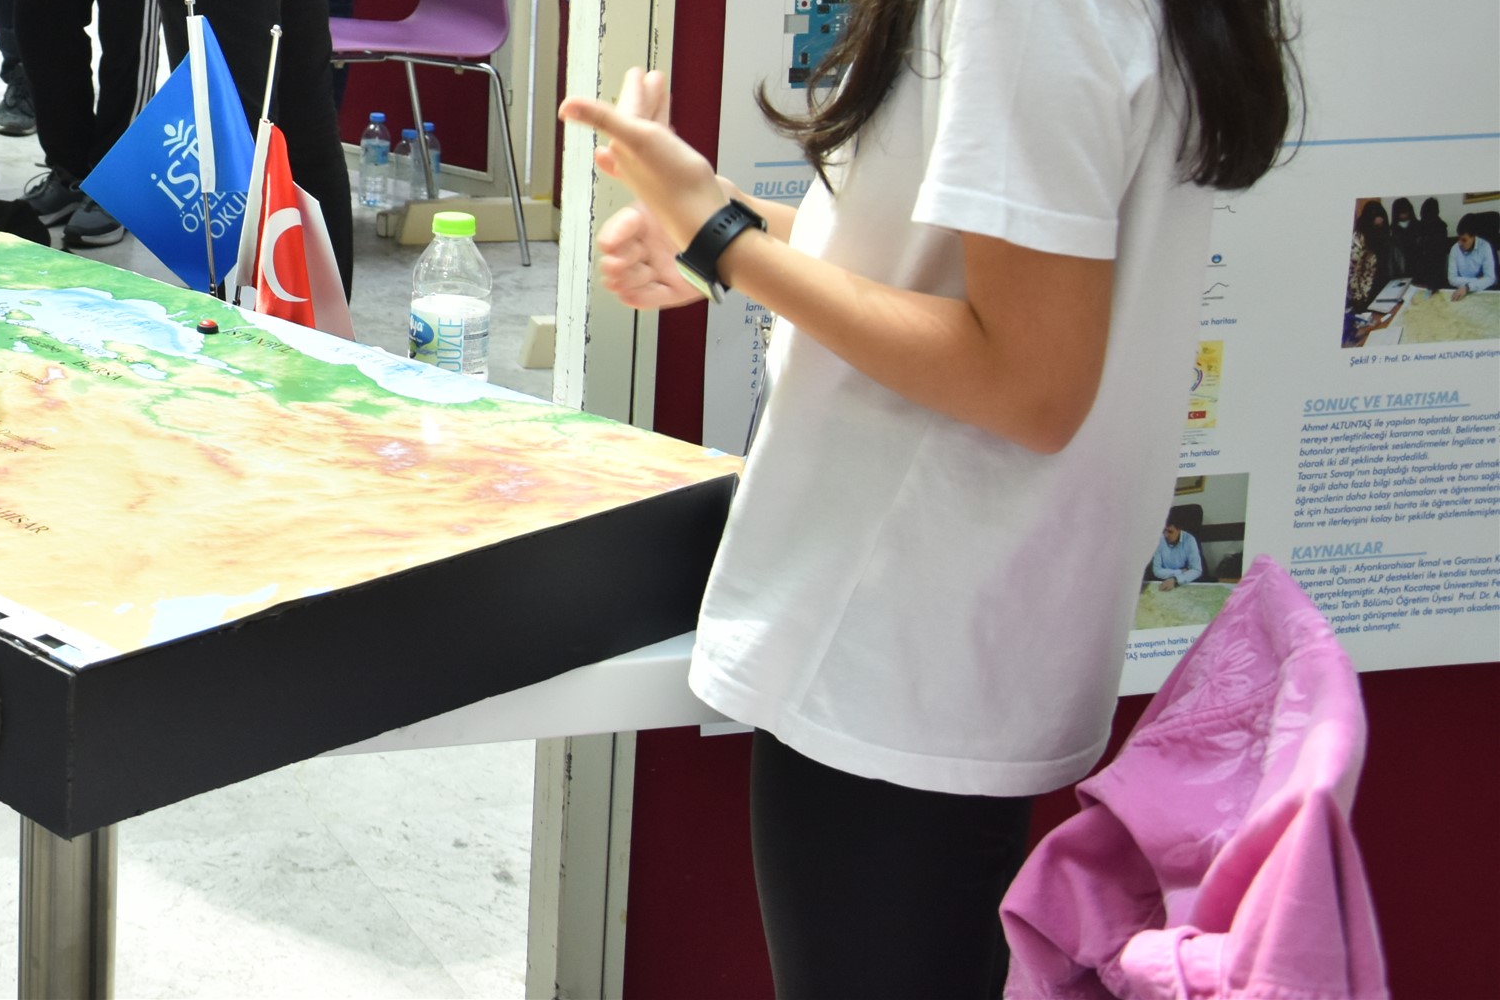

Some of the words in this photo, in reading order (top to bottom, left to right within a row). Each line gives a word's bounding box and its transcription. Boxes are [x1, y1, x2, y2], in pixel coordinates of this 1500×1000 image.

[1350, 356, 1369, 367] Şekil
[1372, 356, 1377, 364] 9
[1438, 351, 1473, 359] ALTUNTAŞ
[1304, 398, 1359, 415] SONUÇ
[1363, 396, 1382, 408] VE
[1386, 391, 1459, 407] TARTIŞMA
[1301, 423, 1329, 432] Ahmet
[1330, 419, 1372, 431] ALTUNTAŞ
[1374, 418, 1384, 426] ile
[1386, 416, 1416, 428] yapılan
[1291, 541, 1383, 560] KAYNAKLAR
